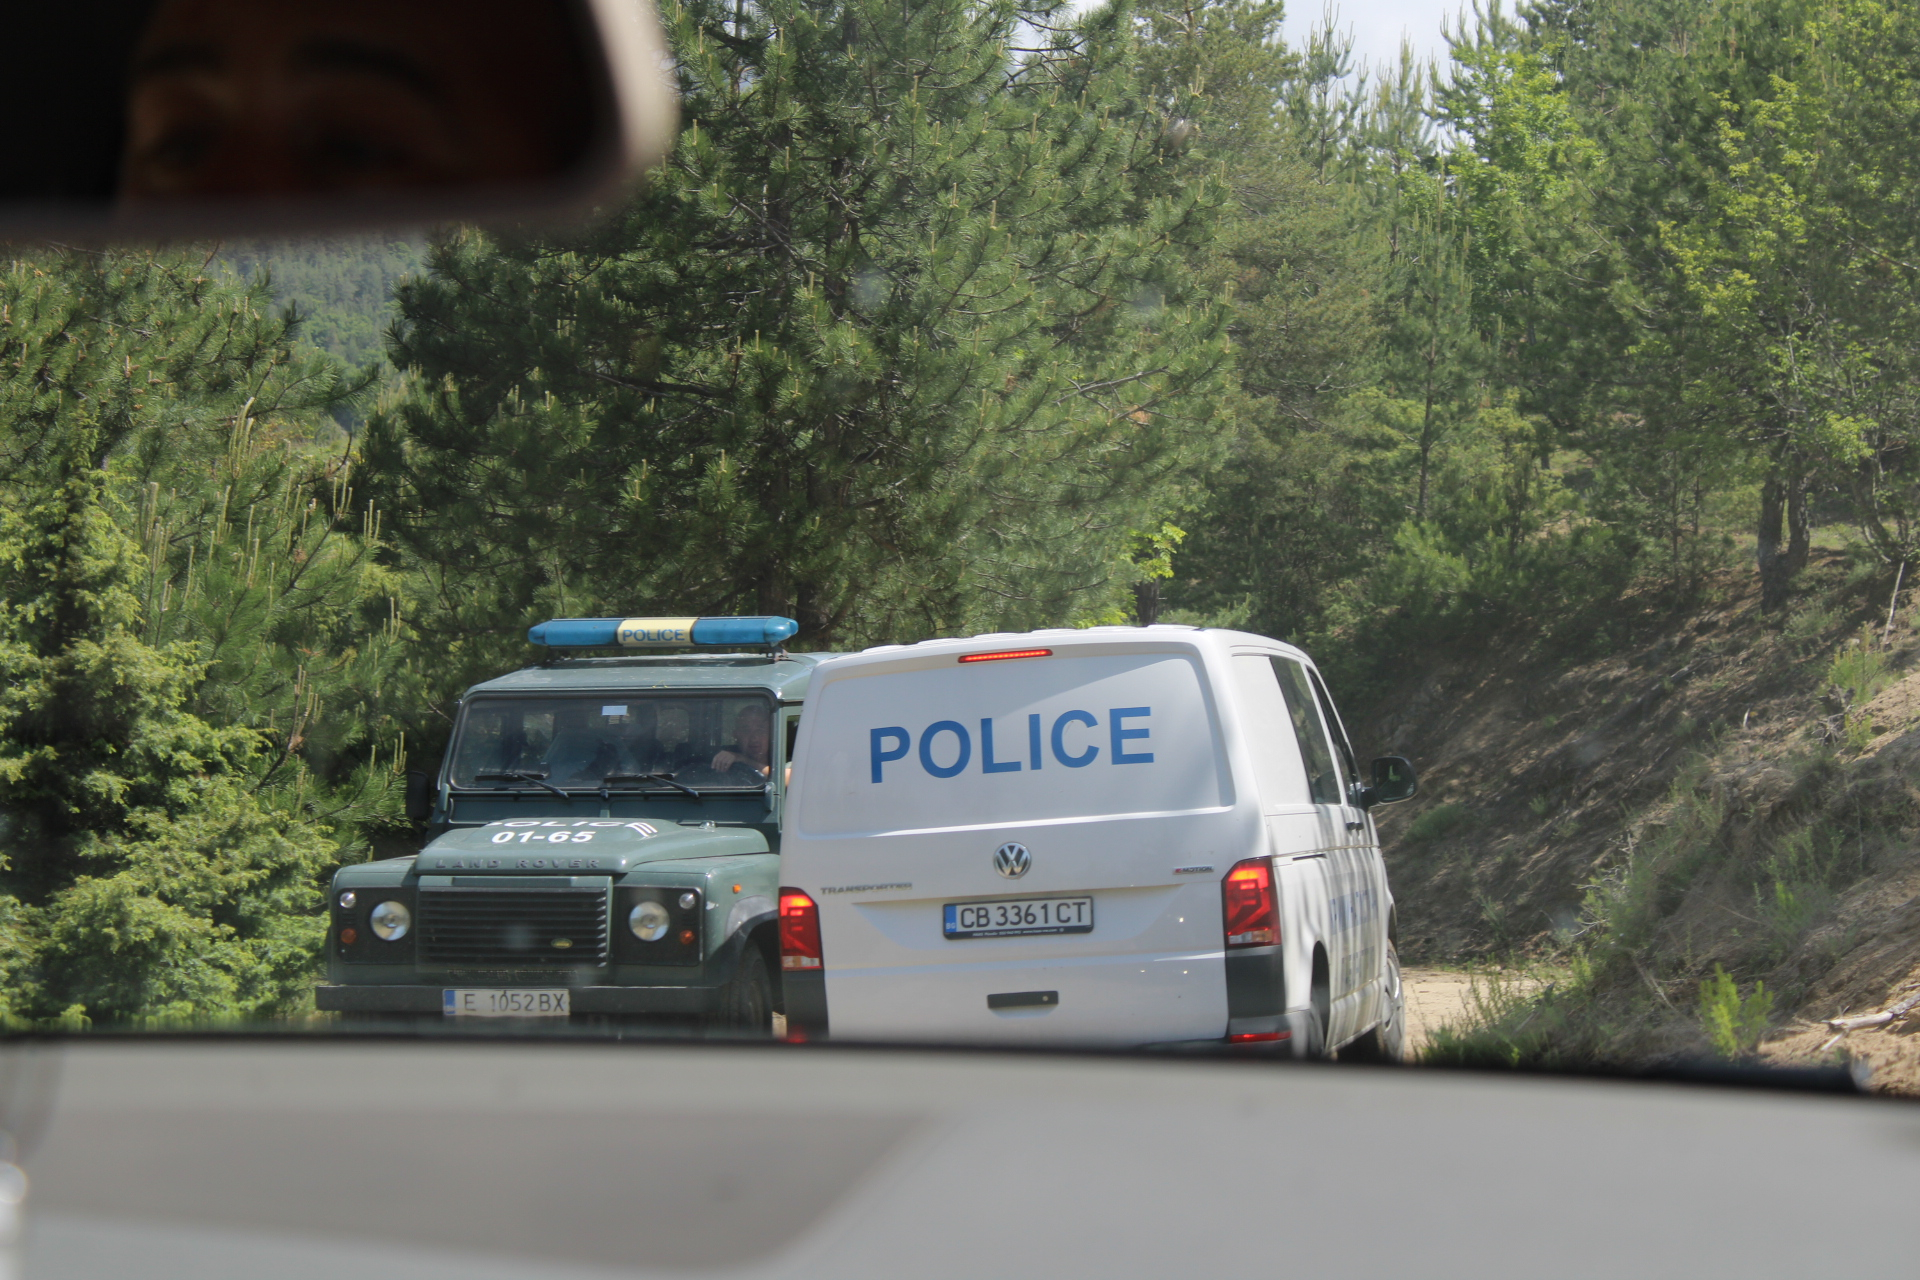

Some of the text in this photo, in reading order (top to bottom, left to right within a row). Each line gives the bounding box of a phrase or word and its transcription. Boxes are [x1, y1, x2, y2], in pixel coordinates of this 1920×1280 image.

[622, 628, 685, 641] POLICE
[870, 706, 1154, 784] POLICE
[491, 831, 596, 844] 01-65
[435, 858, 600, 869] LAND ROVER
[960, 901, 1086, 928] CB 3361 CT
[464, 993, 564, 1012] E 1052 BX
